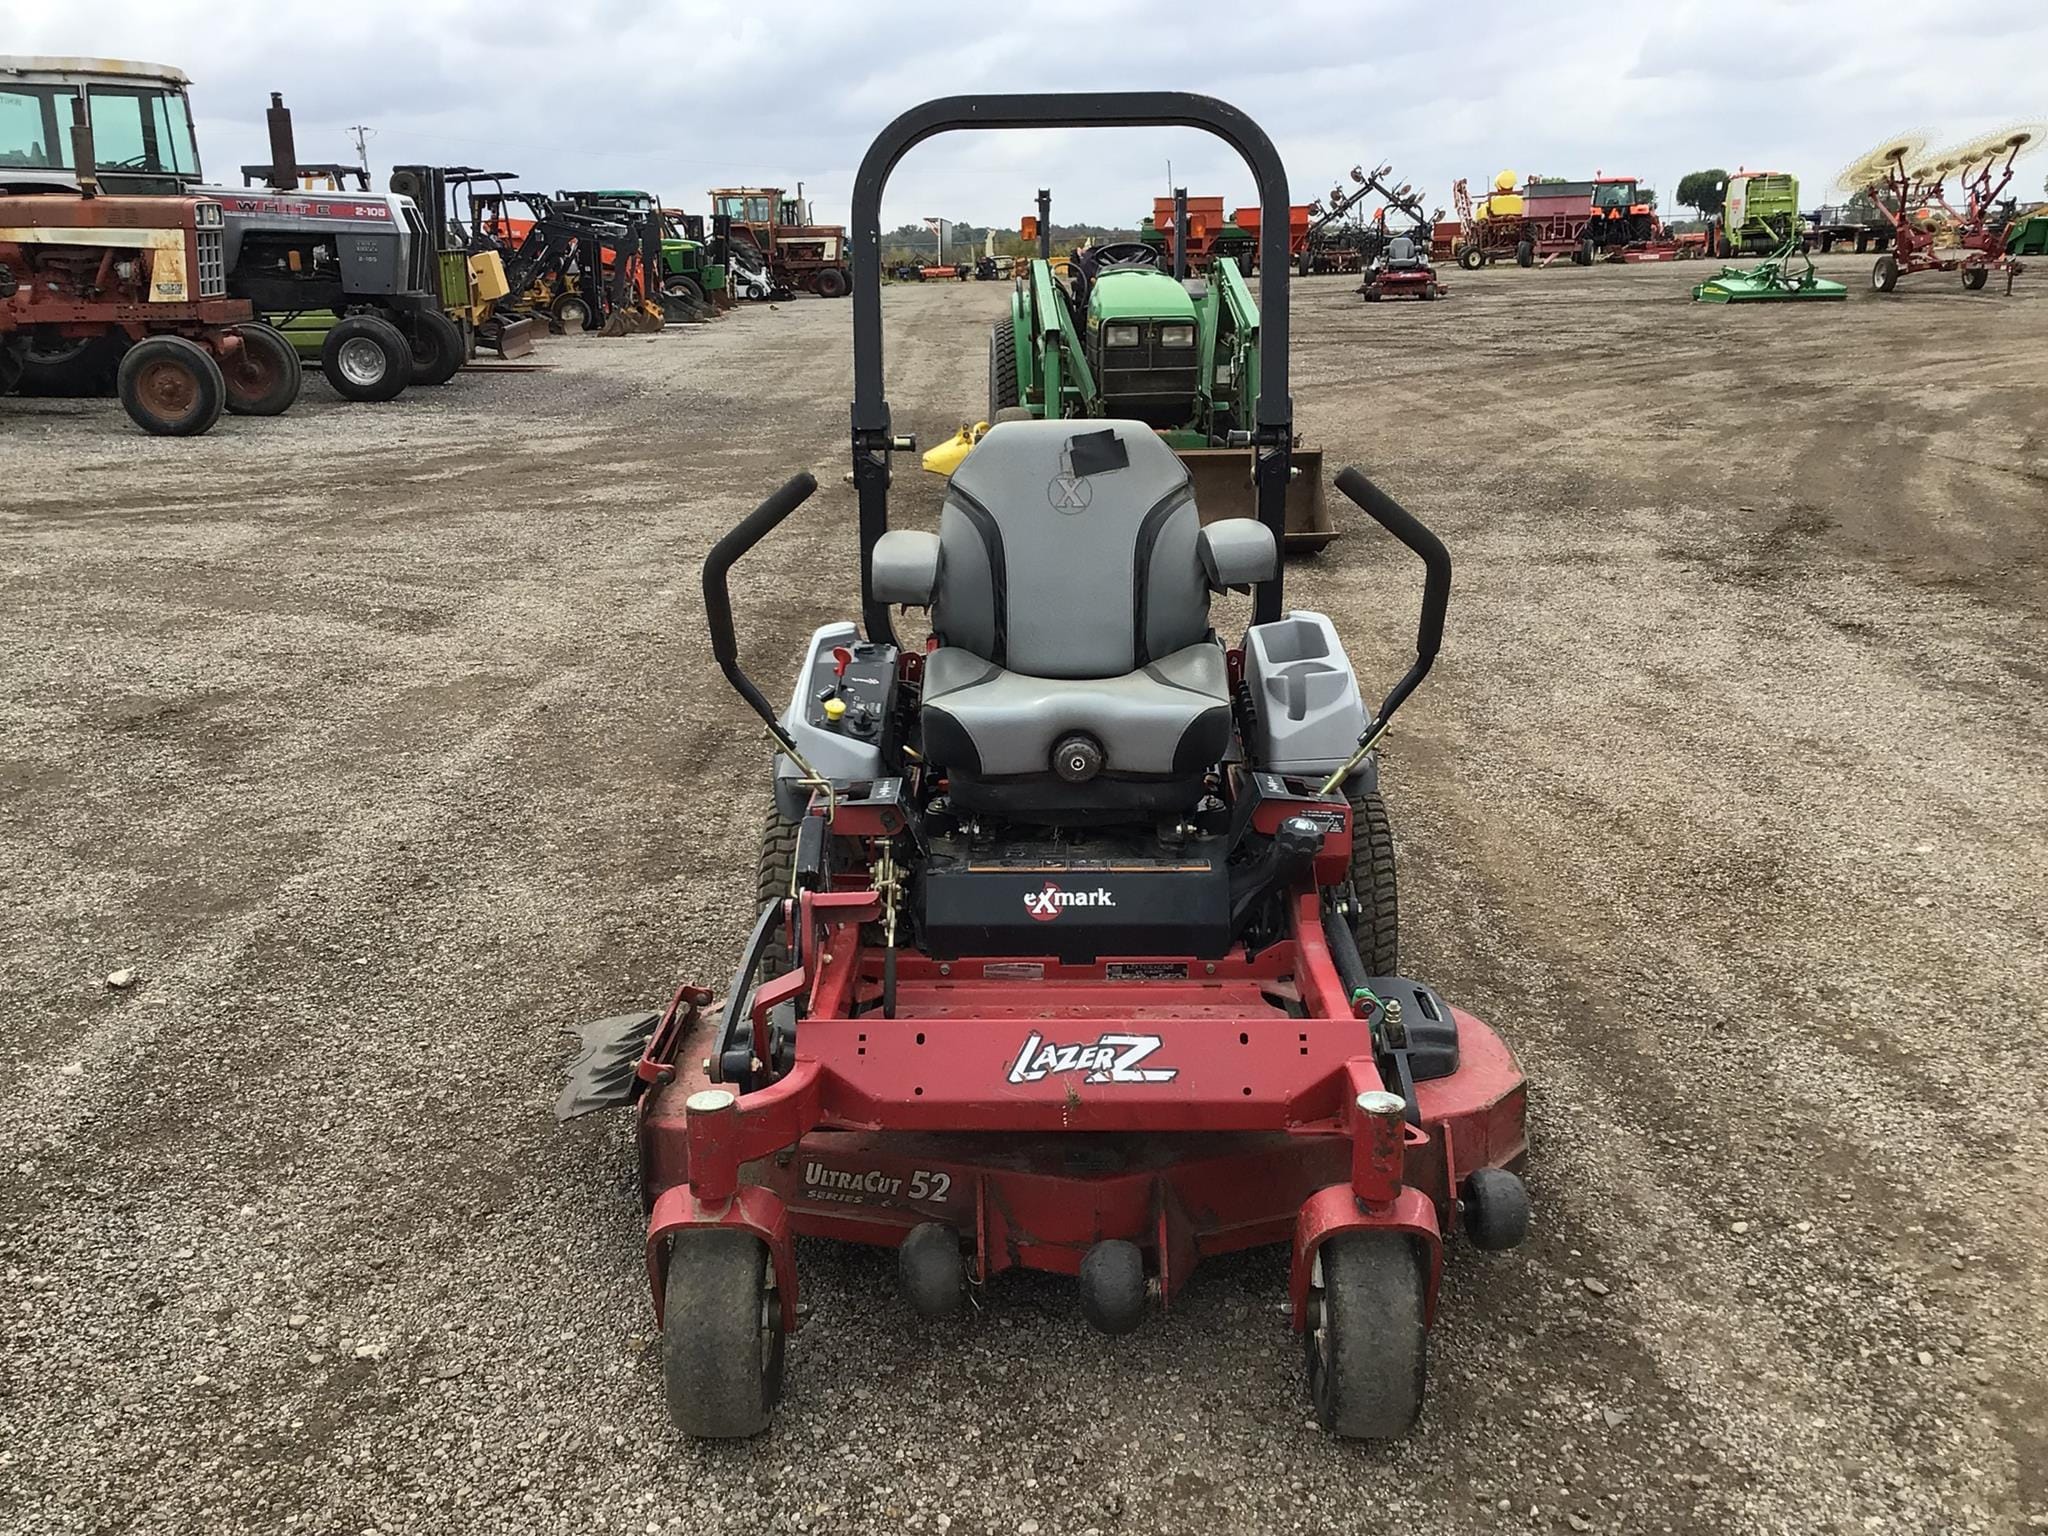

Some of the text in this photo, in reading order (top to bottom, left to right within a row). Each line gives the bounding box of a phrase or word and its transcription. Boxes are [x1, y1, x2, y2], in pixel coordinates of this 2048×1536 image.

[236, 200, 386, 217] WHITE 2-105
[907, 1170, 951, 1203] 52
[807, 1190, 863, 1204] SERIES
